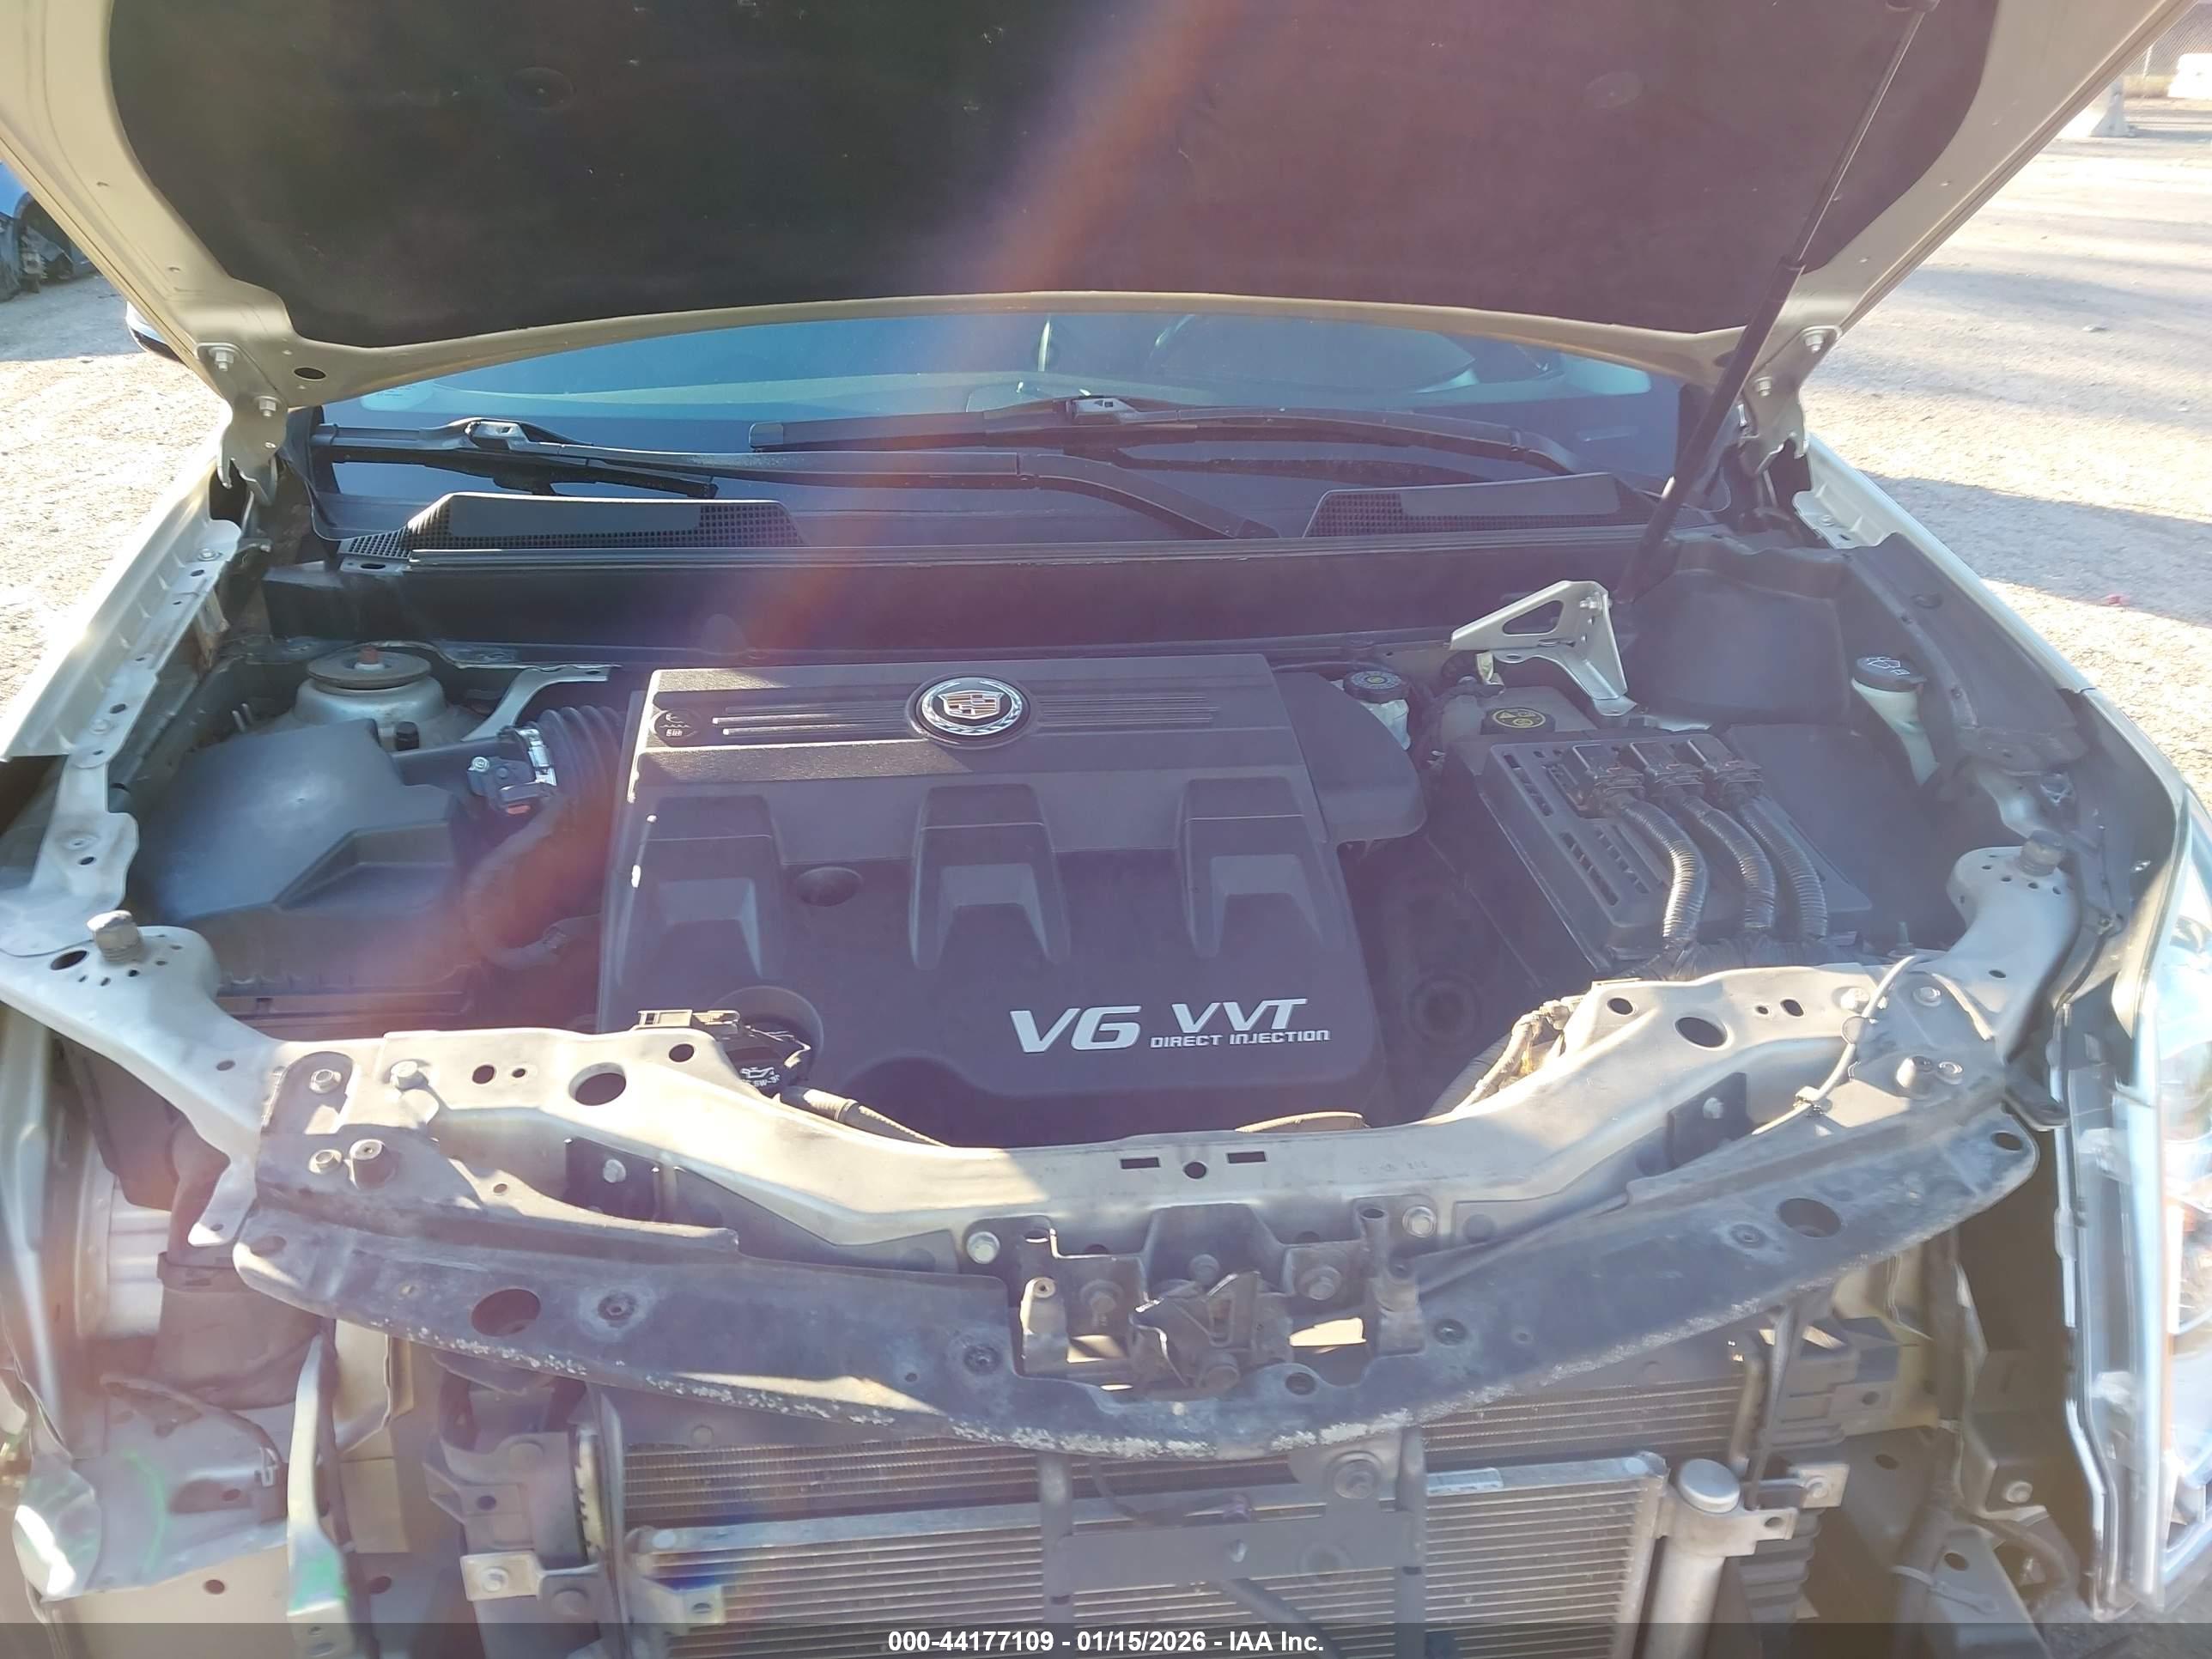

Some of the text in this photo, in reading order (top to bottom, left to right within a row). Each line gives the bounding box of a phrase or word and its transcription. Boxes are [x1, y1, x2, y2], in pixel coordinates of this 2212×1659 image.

[1009, 998, 1309, 1054] V6 VVT
[1149, 1030, 1331, 1048] DIRECT INJECTION
